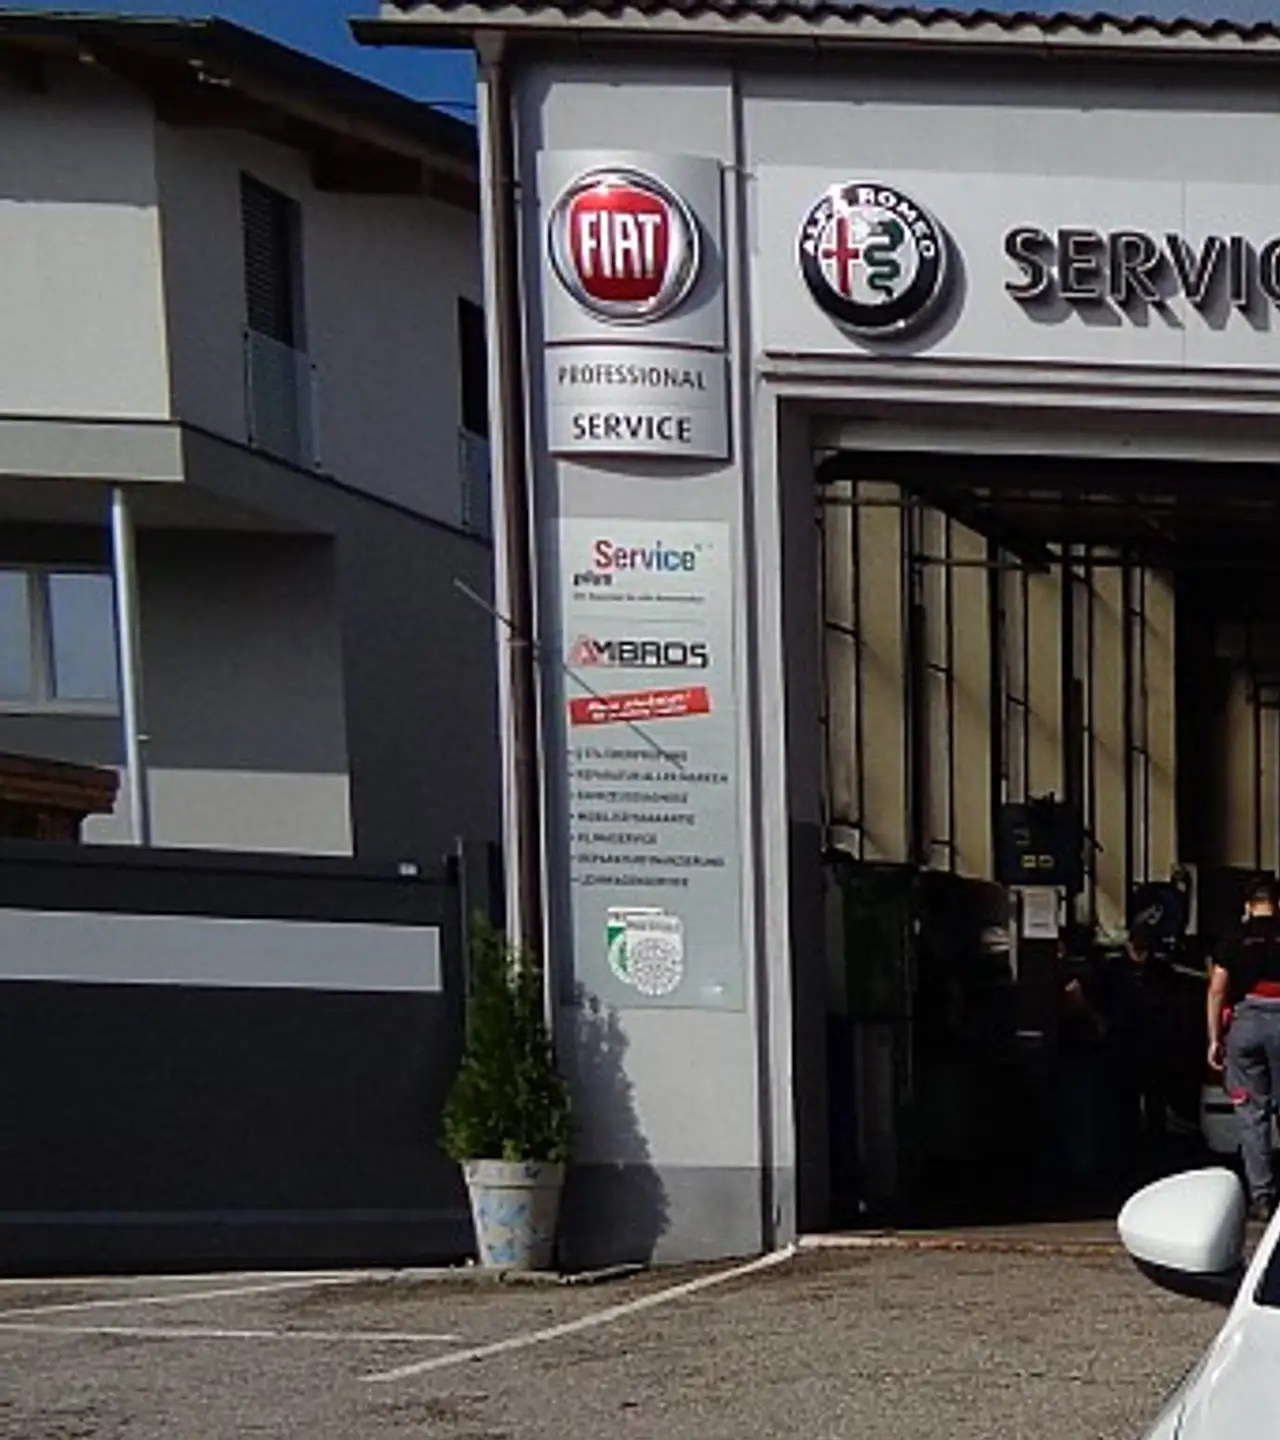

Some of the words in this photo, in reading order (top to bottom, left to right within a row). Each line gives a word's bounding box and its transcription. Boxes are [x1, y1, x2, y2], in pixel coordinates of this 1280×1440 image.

[856, 186, 936, 260] ROMEO
[579, 210, 662, 280] FIAT
[558, 363, 706, 391] PROFESSIONAL
[572, 413, 693, 444] SERVICE
[594, 539, 696, 571] Service
[570, 633, 710, 668] AMBROS
